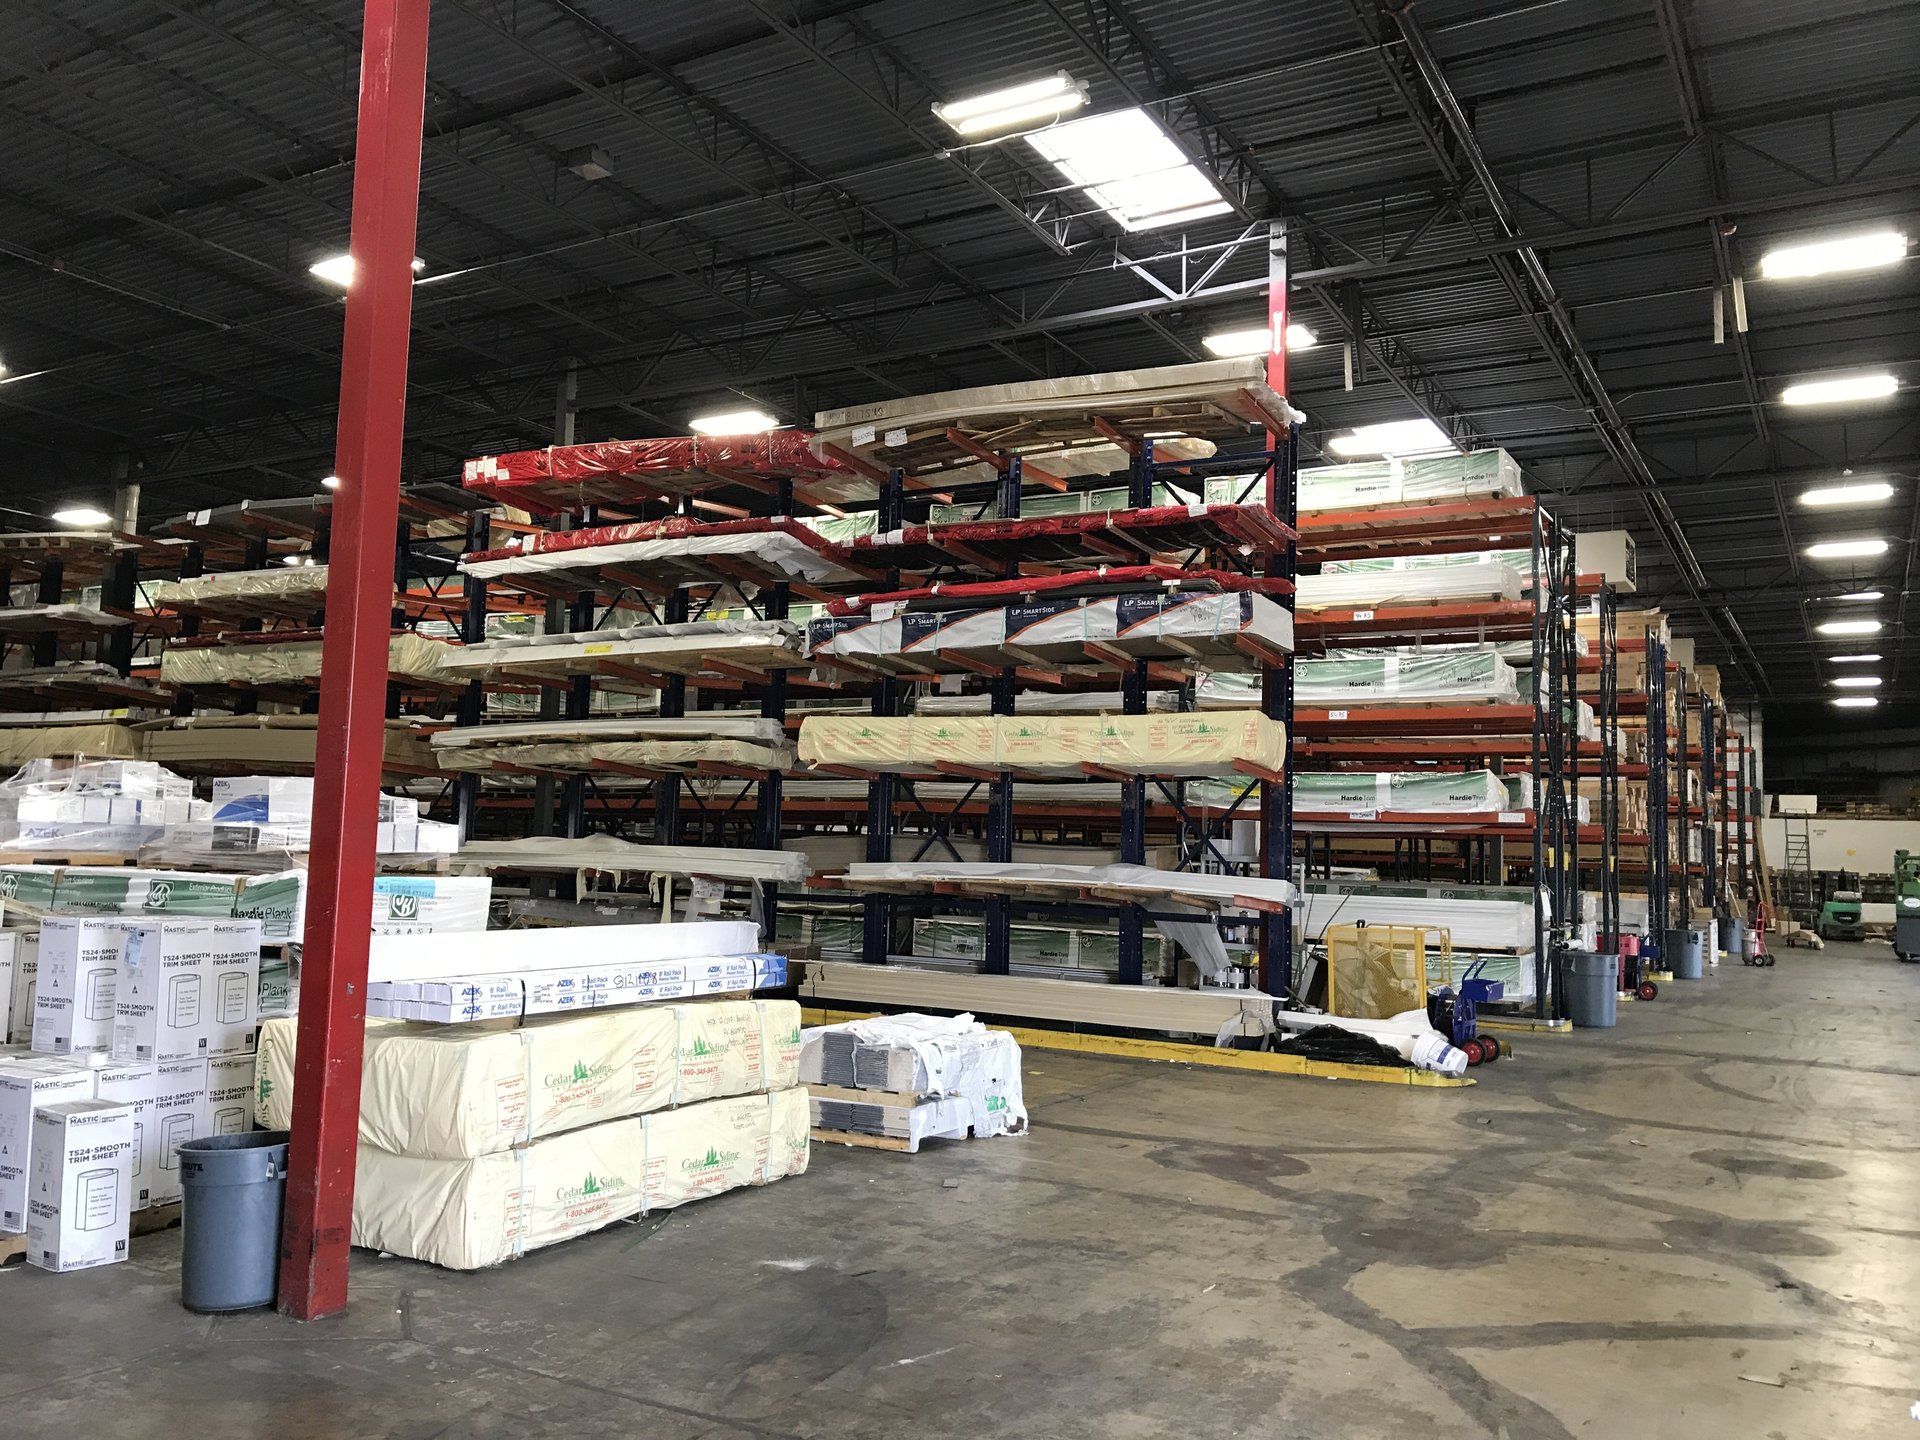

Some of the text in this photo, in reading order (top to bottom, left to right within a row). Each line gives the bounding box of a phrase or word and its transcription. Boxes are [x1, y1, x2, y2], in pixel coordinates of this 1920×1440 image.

[462, 986, 480, 996] AZEK
[462, 1005, 480, 1015] AZEK
[670, 1046, 694, 1058] Cdar
[101, 1074, 126, 1082] MASTIC
[544, 1064, 614, 1088] Cedar Siding
[34, 1081, 60, 1090] MASTIC
[173, 1098, 195, 1107] SHEET
[69, 1116, 99, 1125] MASTIC
[68, 1150, 119, 1164] TRIM SHEET
[682, 1157, 704, 1170] Cedar
[556, 1176, 625, 1200] Cedar Siding
